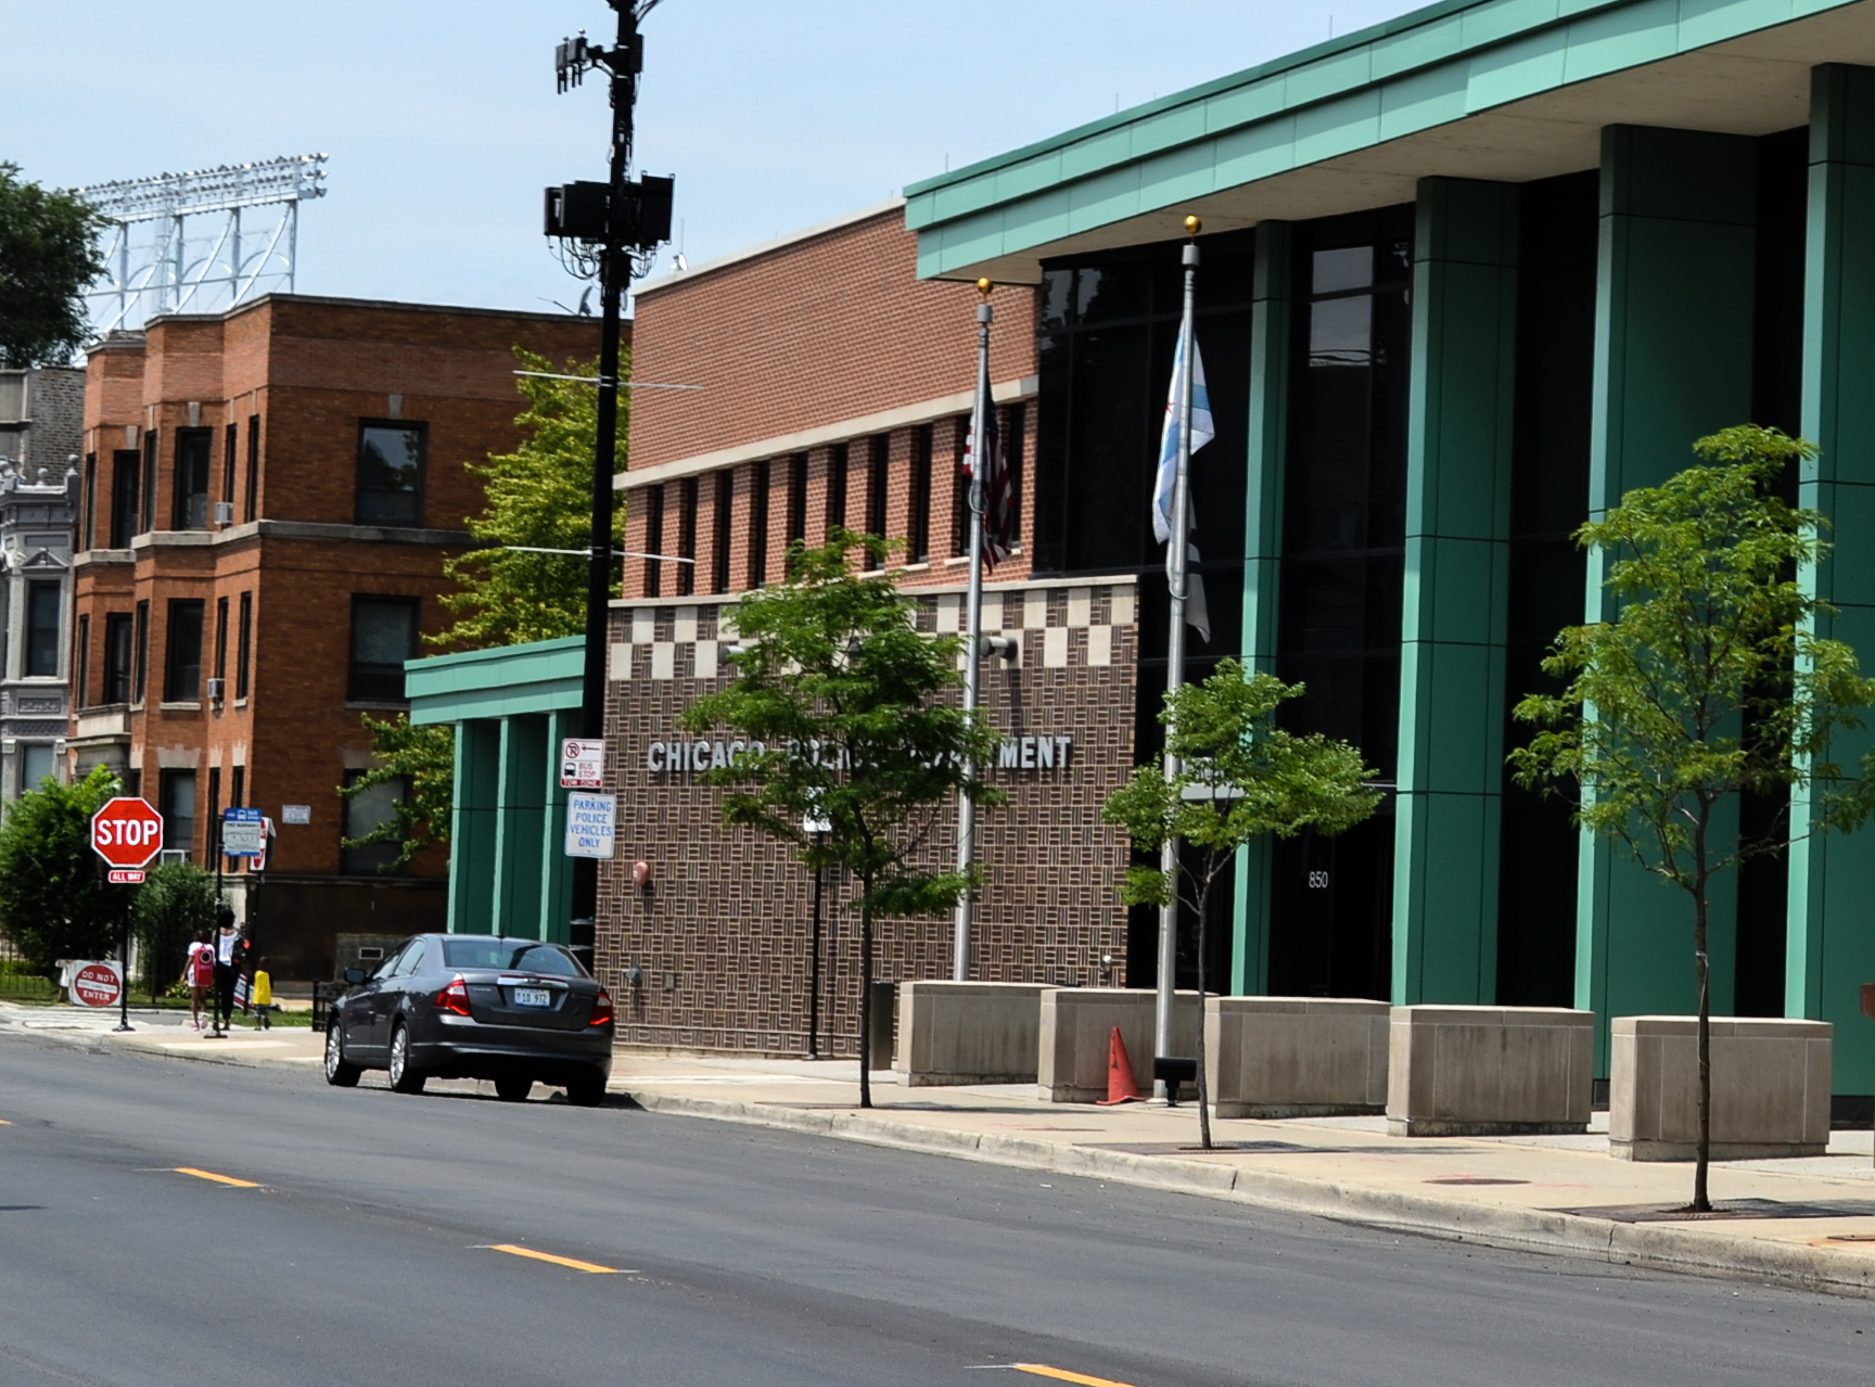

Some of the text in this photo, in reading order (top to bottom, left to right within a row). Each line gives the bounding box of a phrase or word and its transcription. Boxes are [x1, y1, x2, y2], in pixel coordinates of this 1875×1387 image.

[648, 740, 766, 771] CHICAGO
[573, 800, 612, 812] PARKING
[575, 812, 607, 824] POLICE
[97, 819, 158, 846] STOP
[570, 824, 612, 837] VEHICLES
[578, 837, 600, 848] ONLY
[112, 872, 142, 881] ALL WAY
[1309, 871, 1328, 888] 850
[82, 971, 115, 983] DO NOT
[83, 990, 110, 1001] ENTER
